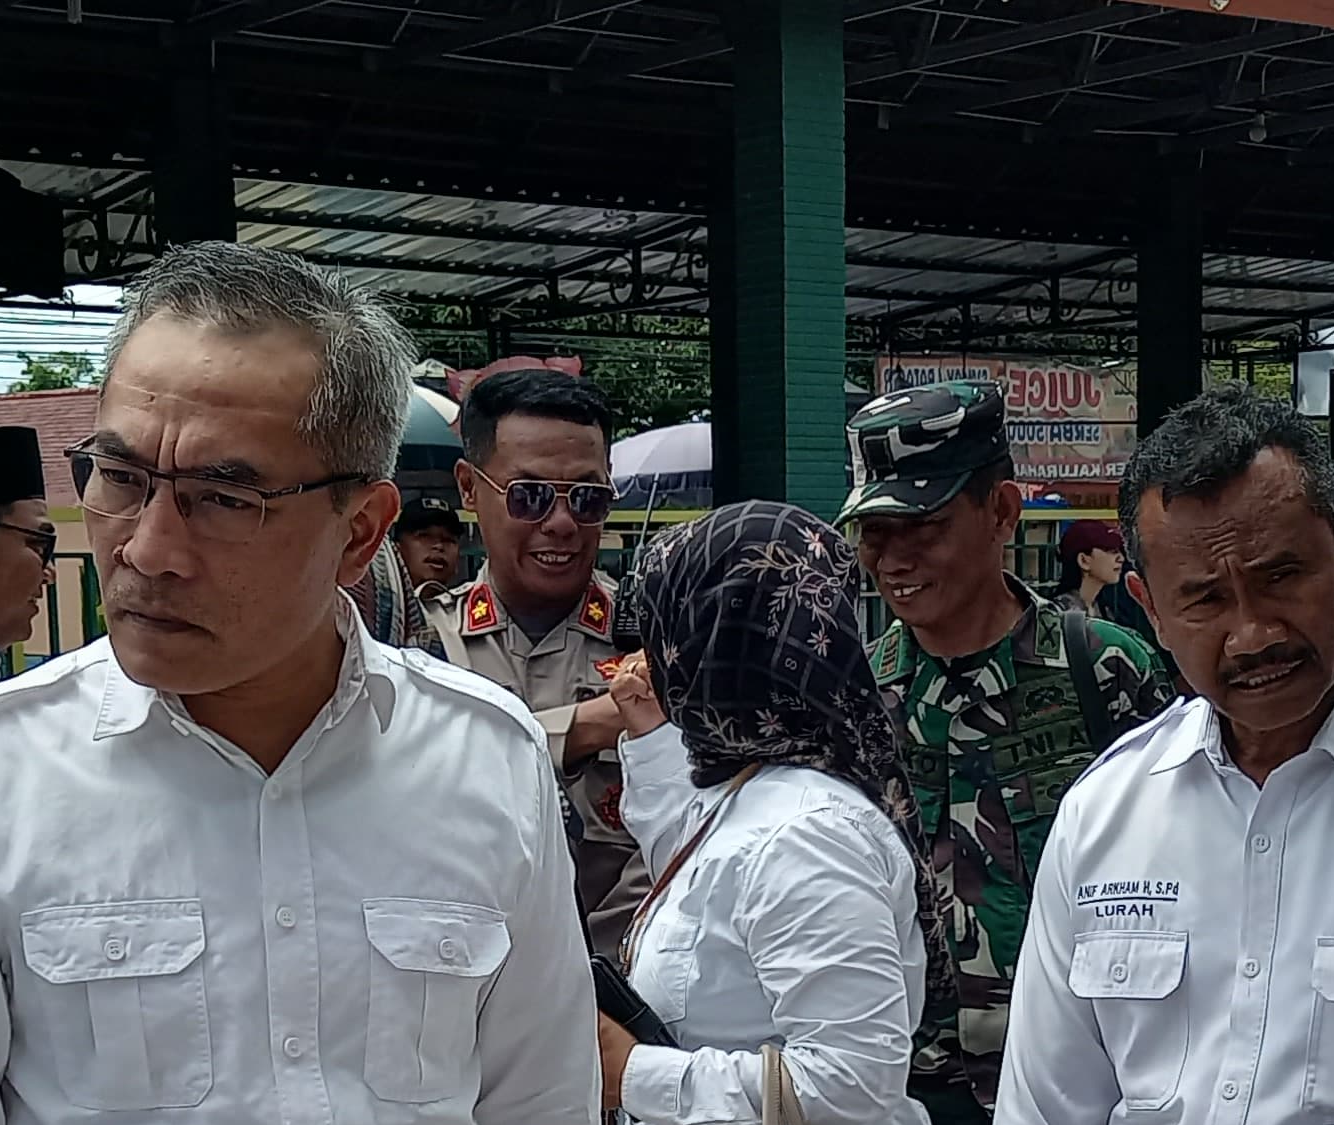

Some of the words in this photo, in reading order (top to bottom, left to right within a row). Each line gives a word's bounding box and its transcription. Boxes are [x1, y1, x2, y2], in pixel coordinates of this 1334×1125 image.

[1006, 731, 1057, 766] TNI
[1068, 724, 1090, 749] A
[1095, 904, 1154, 919] LURAH
